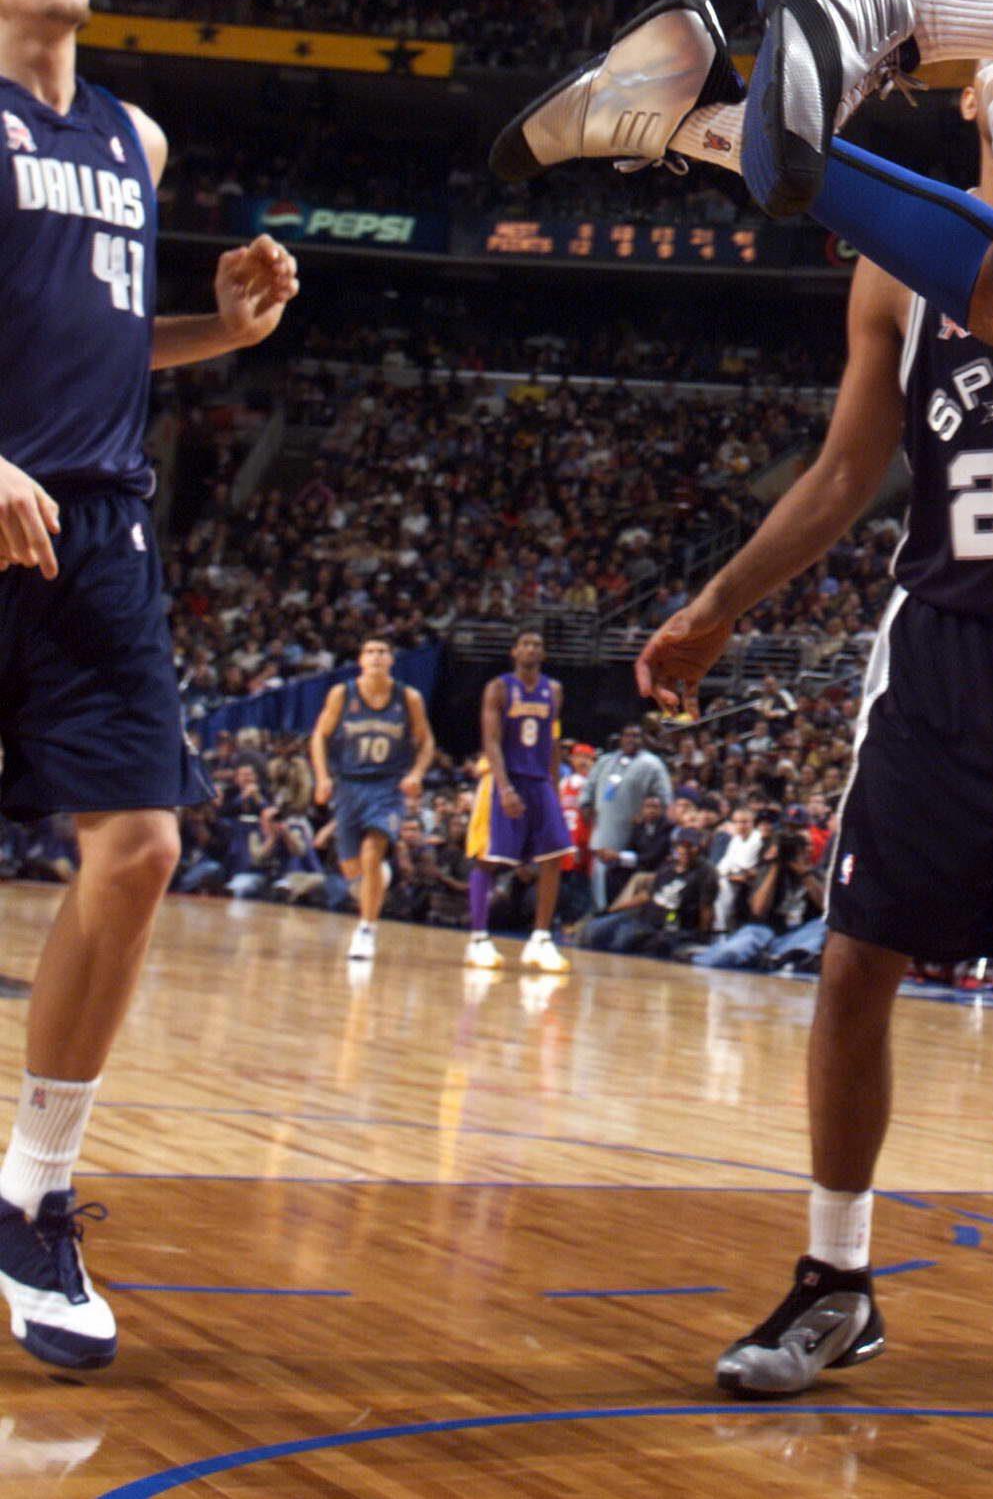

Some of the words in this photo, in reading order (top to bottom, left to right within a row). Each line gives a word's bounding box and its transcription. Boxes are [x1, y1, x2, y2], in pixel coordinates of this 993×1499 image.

[13, 153, 146, 230] DALLAS
[305, 208, 415, 244] PEPSI
[92, 231, 146, 318] 41
[358, 736, 390, 764] 10
[521, 718, 539, 747] 8
